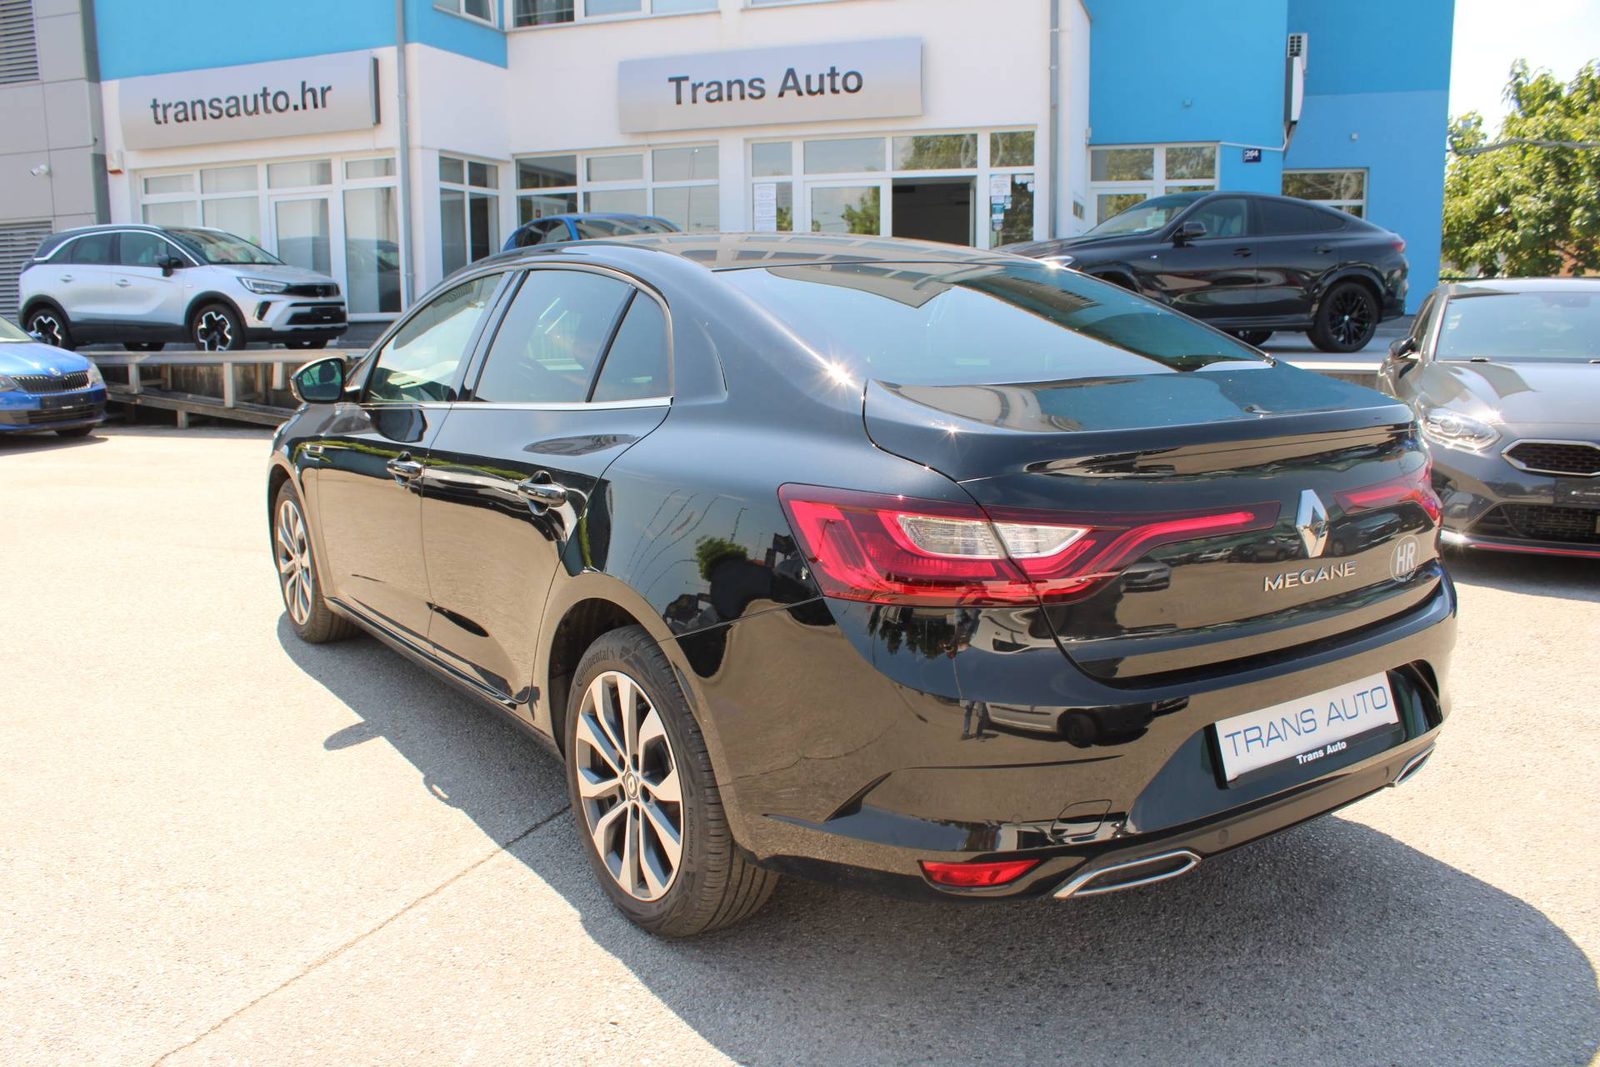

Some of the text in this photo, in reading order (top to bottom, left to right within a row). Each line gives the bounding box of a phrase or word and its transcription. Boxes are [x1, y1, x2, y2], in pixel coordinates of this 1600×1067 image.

[150, 80, 332, 125] transauto.hr
[668, 66, 863, 105] Trans Auto
[1395, 542, 1416, 574] HR
[1264, 561, 1356, 592] MEGANE
[1225, 686, 1388, 757] TRANS AUTO
[1296, 741, 1347, 765] Trans Auto
